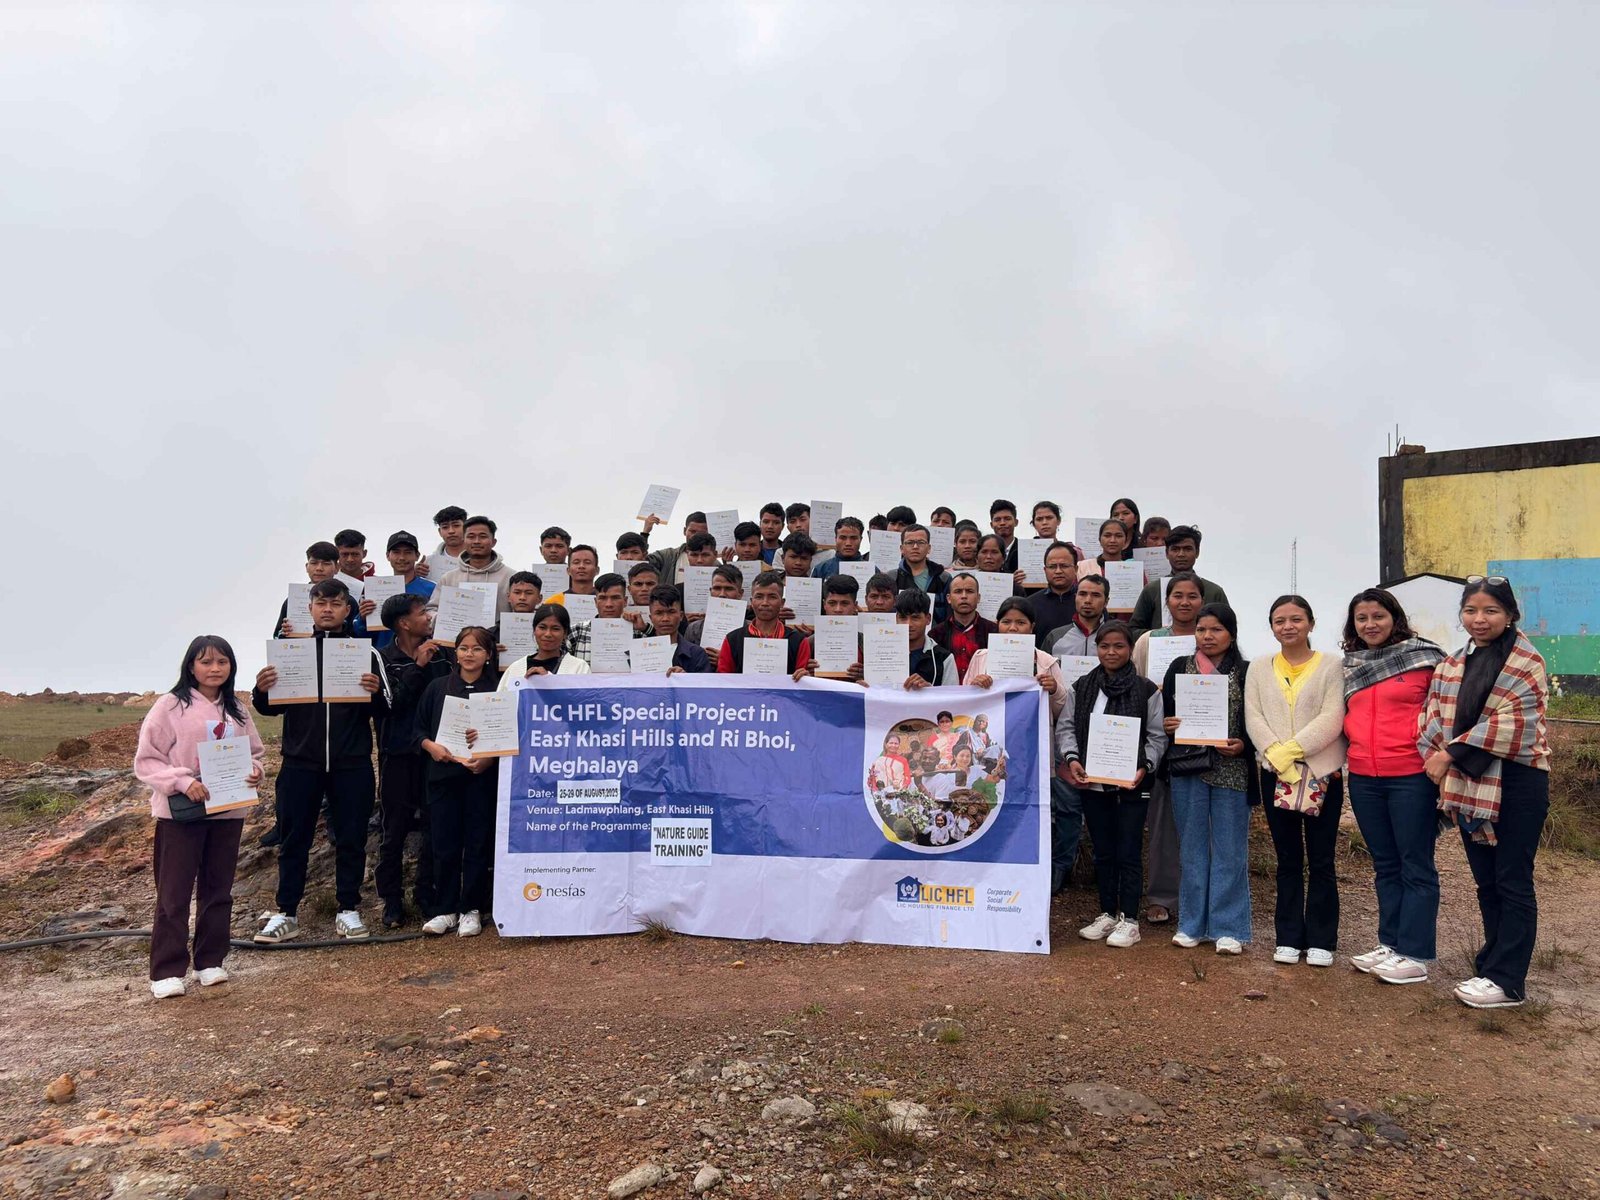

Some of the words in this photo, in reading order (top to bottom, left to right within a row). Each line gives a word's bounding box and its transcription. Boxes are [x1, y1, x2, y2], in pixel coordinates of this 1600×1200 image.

[532, 704, 562, 722] LIC
[568, 704, 606, 721] HFL
[611, 702, 681, 725] Special
[686, 703, 755, 725] Project
[760, 704, 778, 722] in
[530, 730, 571, 748] East
[576, 729, 626, 747] Khasi
[631, 729, 674, 747] Hills
[678, 729, 714, 747] and
[720, 730, 739, 747] Ri
[745, 731, 796, 751] Bhoi,
[529, 756, 639, 778] Meghalaya
[528, 789, 554, 798] Date:
[559, 789, 574, 799] 25-29
[575, 788, 583, 799] OF
[527, 805, 562, 815] Venue:
[565, 805, 644, 817] Ladmawphlang,
[647, 805, 666, 814] East
[668, 804, 692, 815] Khasi
[694, 805, 714, 815] Hills
[526, 822, 556, 831] Name
[559, 821, 570, 831] of
[572, 821, 588, 831] the
[591, 821, 651, 834] Programme:
[653, 826, 685, 840] "NATURE
[686, 827, 709, 840] GUIDE
[654, 844, 709, 857] TRAINING"
[546, 883, 586, 897] nesfas
[921, 887, 943, 902] LIC
[946, 888, 973, 904] HFL
[987, 888, 1012, 897] Corporate
[987, 896, 1002, 904] Social
[987, 904, 1022, 914] Responsibility
